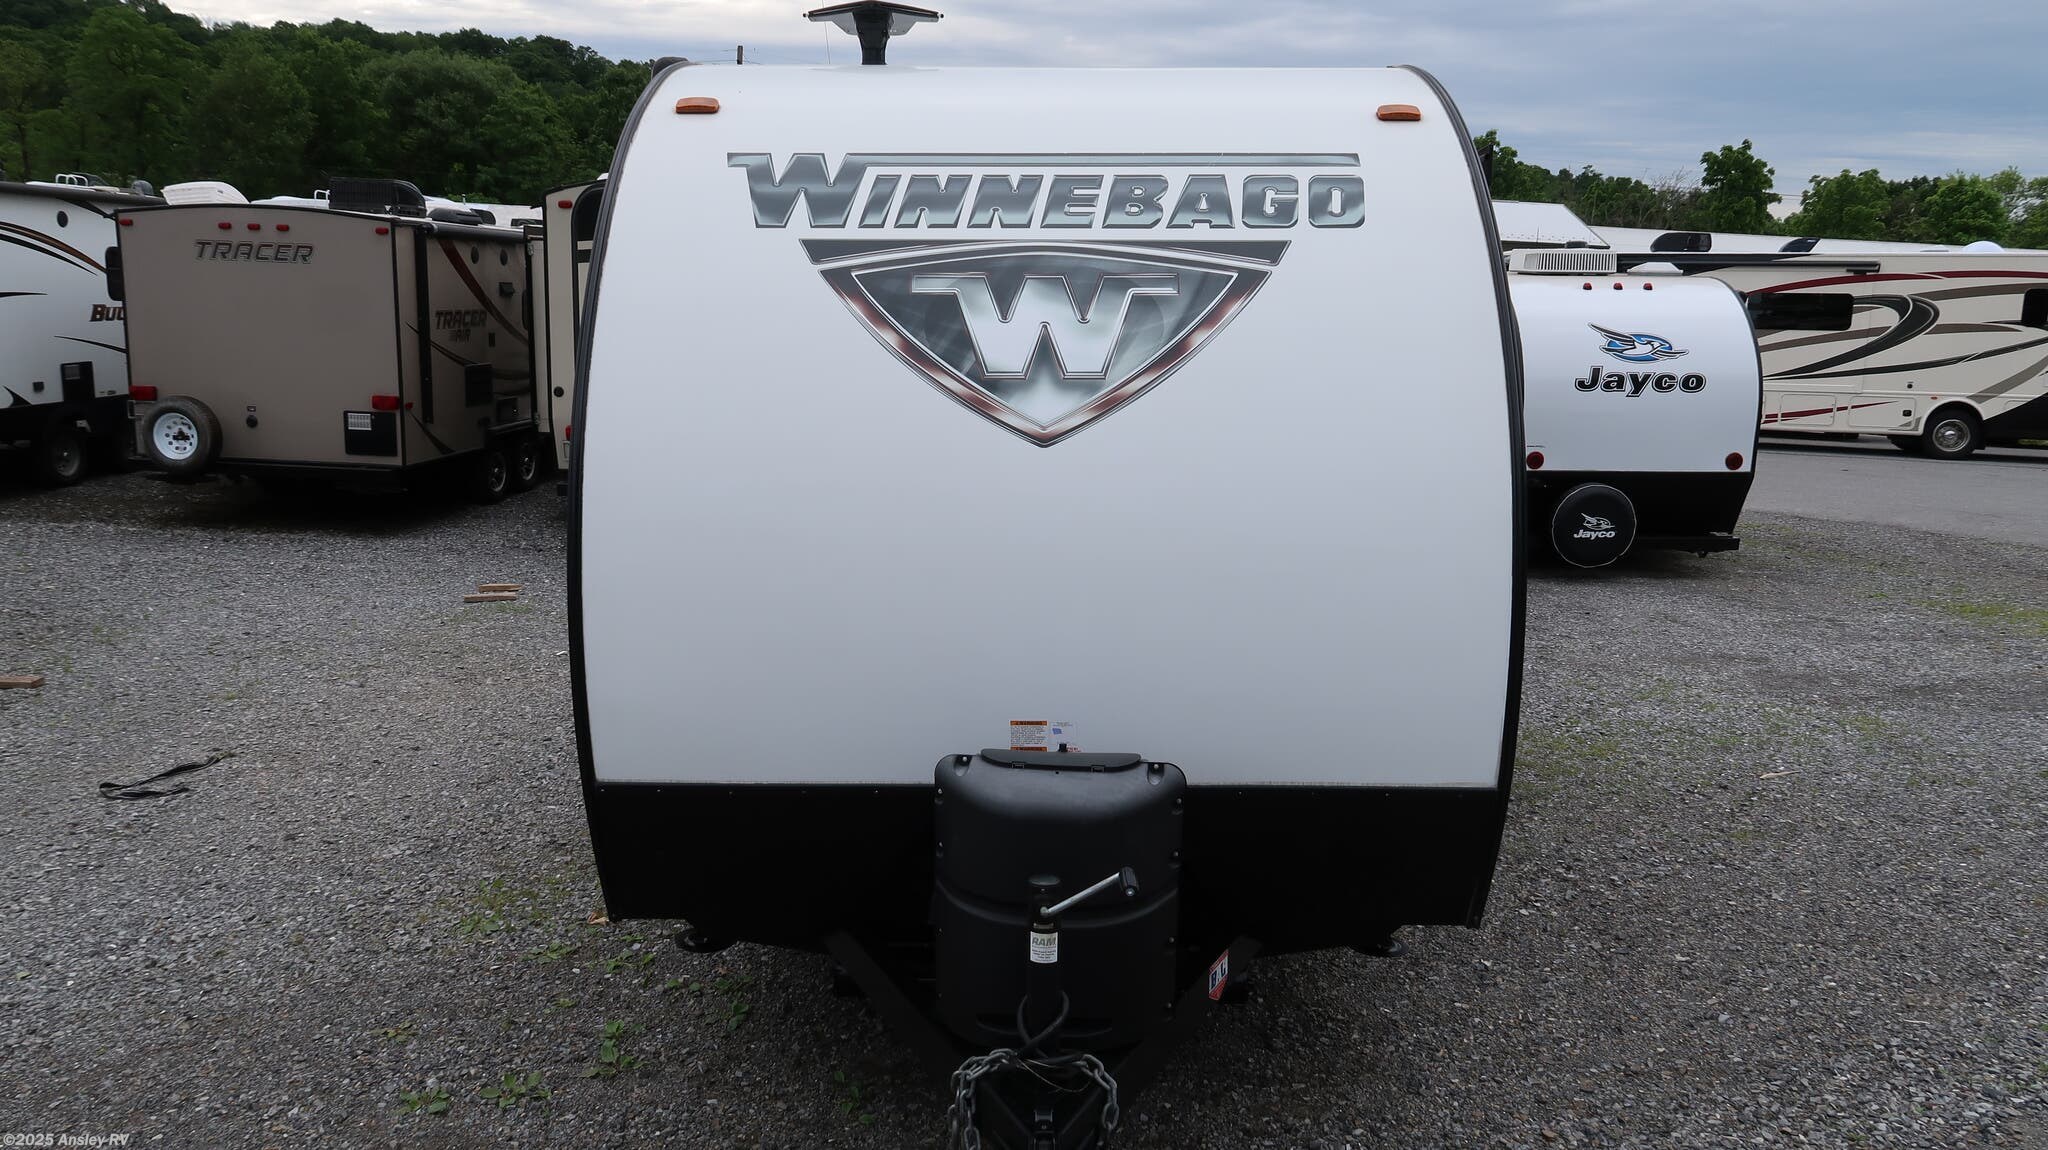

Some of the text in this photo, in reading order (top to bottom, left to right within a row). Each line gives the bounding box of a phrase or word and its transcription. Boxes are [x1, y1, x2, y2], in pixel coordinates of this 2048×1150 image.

[727, 152, 1366, 229] WINNEBAGO
[195, 239, 314, 264] TRACER
[435, 309, 487, 330] TRACER
[911, 272, 1180, 380] W
[1574, 365, 1707, 398] Jayco
[1573, 529, 1616, 541] Jayco
